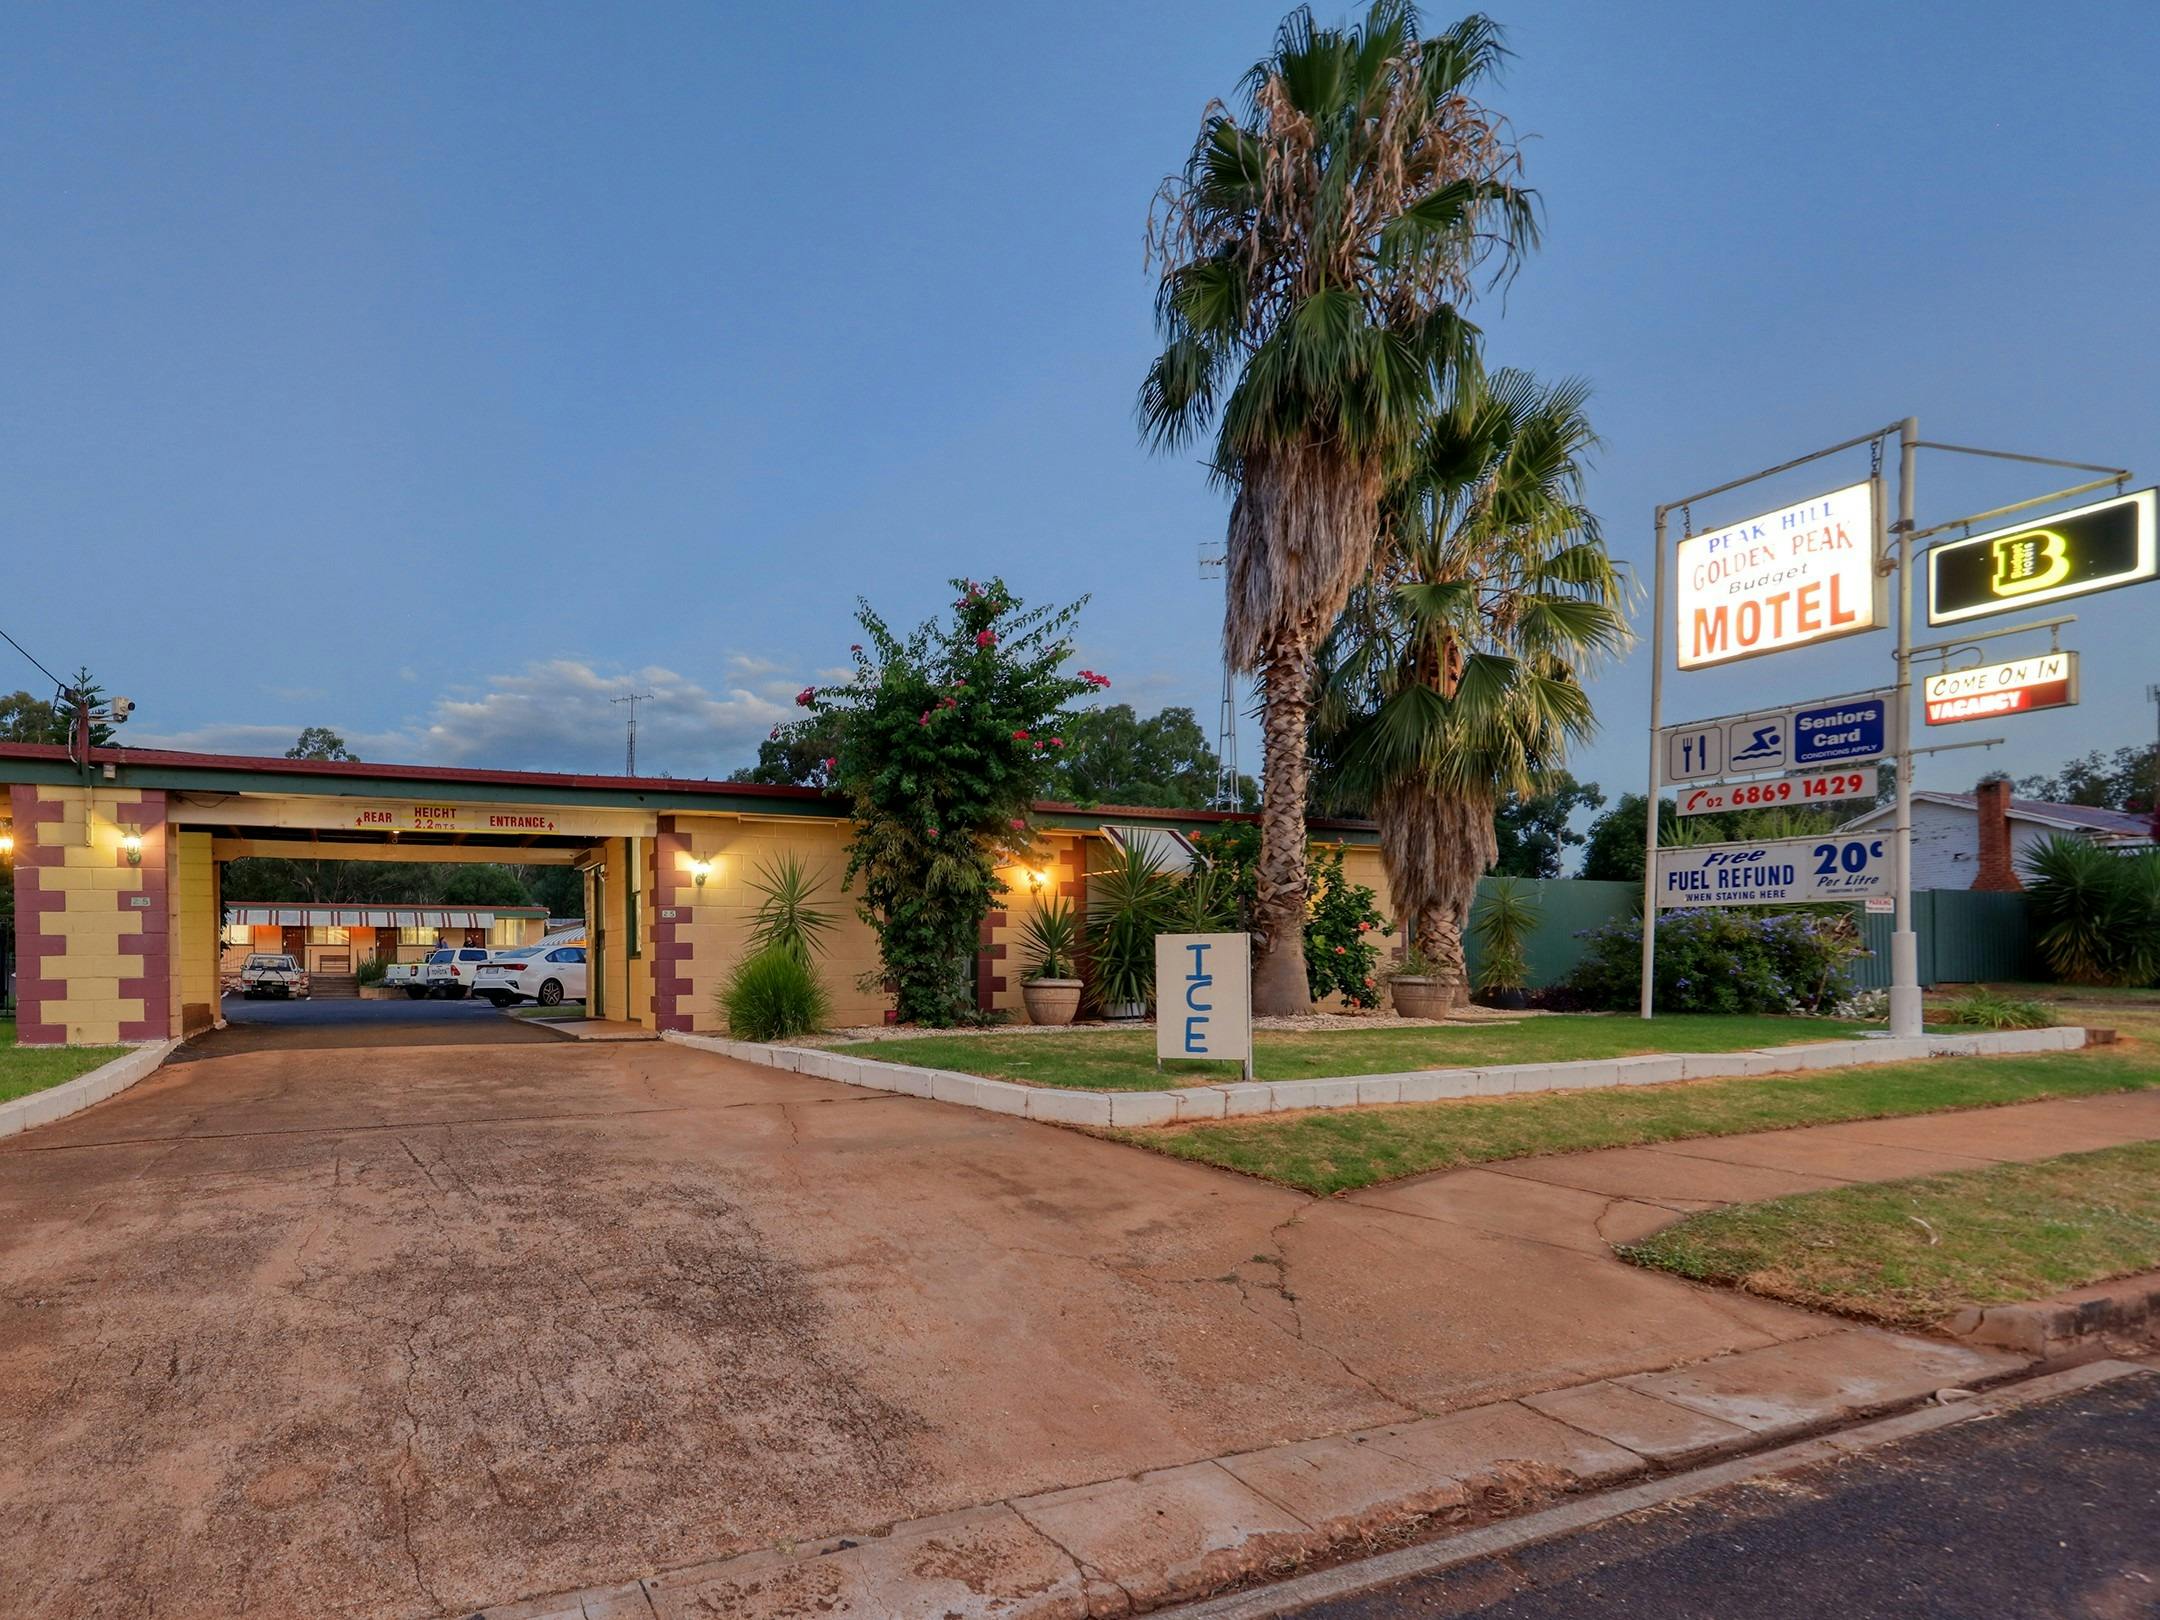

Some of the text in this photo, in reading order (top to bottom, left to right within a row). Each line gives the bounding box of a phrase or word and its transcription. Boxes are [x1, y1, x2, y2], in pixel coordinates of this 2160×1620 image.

[1708, 502, 1833, 553] PEAK HILL
[1693, 521, 1853, 591] GOLDEN PEAK
[1728, 562, 1809, 595] Budget
[1693, 573, 1856, 658] MOTEL
[1933, 659, 2060, 697] COME ON IN
[1929, 690, 2023, 721] VACANCY
[1799, 709, 1877, 731] Seniors
[1813, 728, 1862, 748] Card
[1801, 743, 1878, 760] CONDITIONS APPLY
[1706, 774, 1863, 809] 02 6869 1429
[363, 811, 393, 824] REAR
[414, 807, 457, 820] HEIGHT
[489, 815, 546, 829] ENTRANCE
[1702, 850, 1766, 868] Free
[1668, 864, 1794, 892] FUEL REFUND
[1816, 874, 1880, 888] Per Litre
[1685, 889, 1787, 902] WHEN STAYING HERE
[1185, 944, 1213, 1053] ICE
